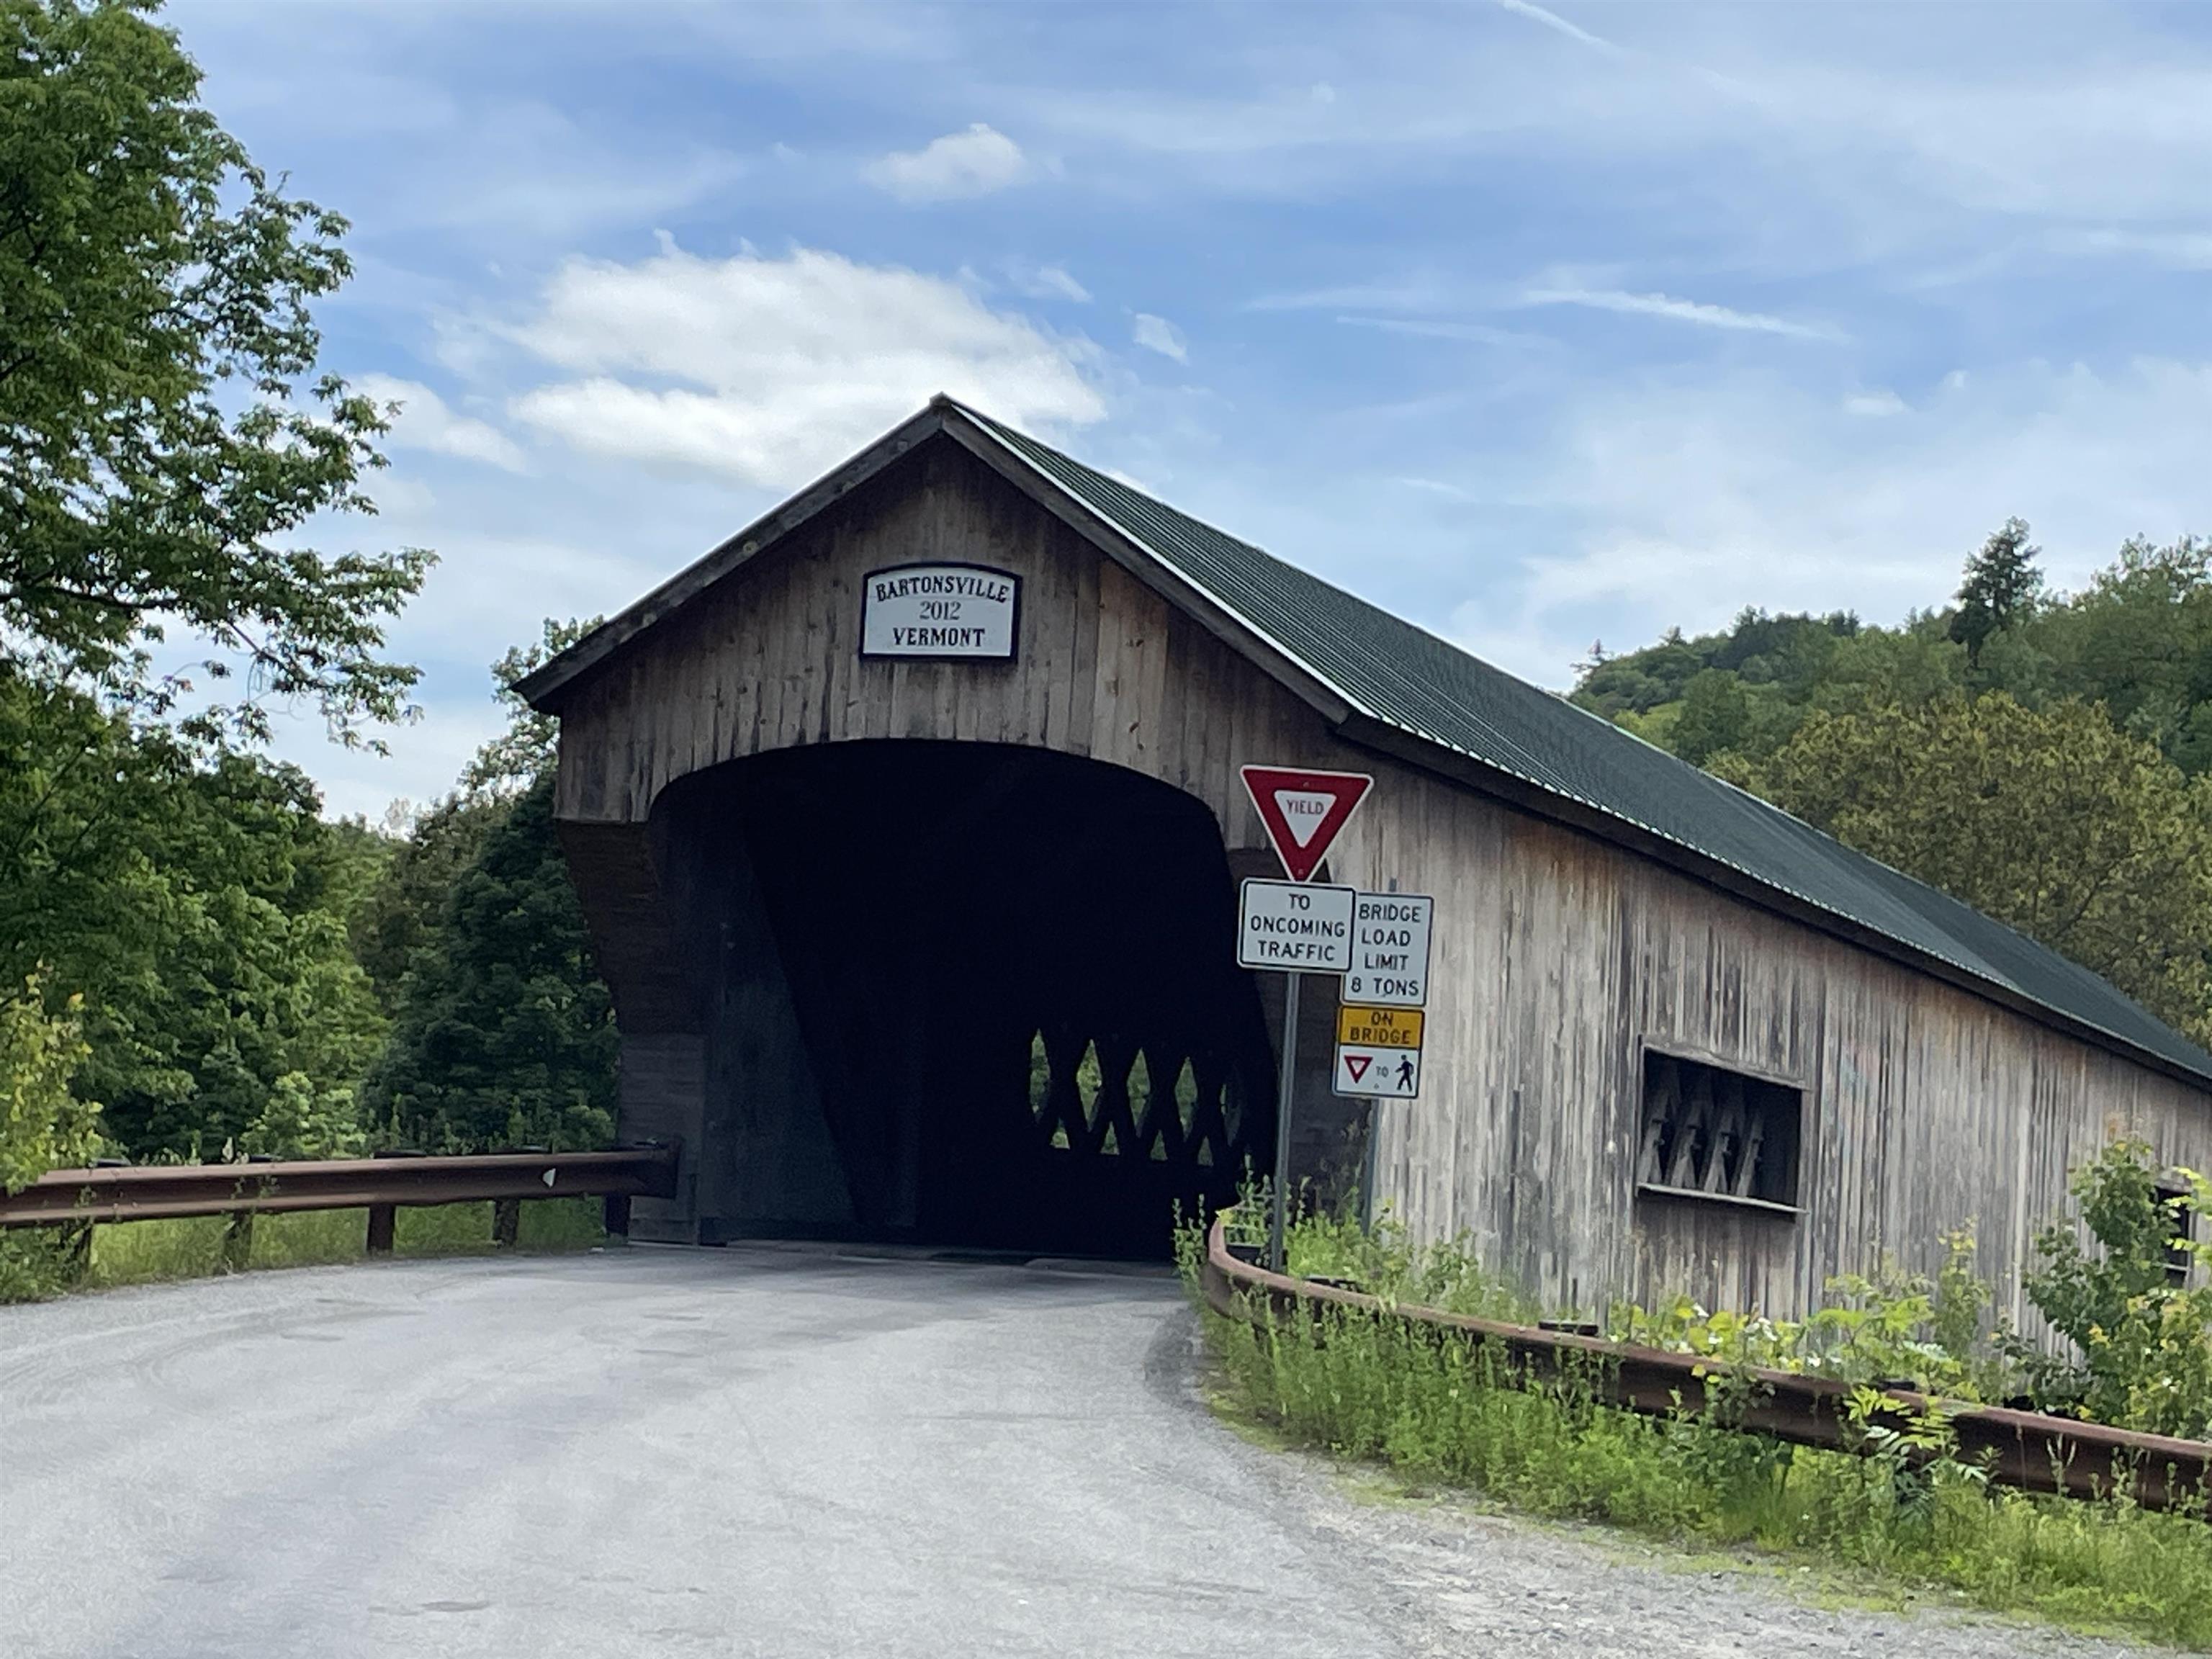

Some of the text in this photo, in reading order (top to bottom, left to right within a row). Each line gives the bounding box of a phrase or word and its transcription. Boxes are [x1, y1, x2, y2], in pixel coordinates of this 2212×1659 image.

[876, 575, 1010, 603] BARTONSVILLE
[920, 601, 961, 621] 2012
[893, 627, 985, 647] VERMONT
[1285, 799, 1324, 815] YIELD
[1288, 894, 1310, 910] TO
[1359, 904, 1422, 923] BRIDGE
[1250, 915, 1345, 938] ONCOMING
[1361, 927, 1411, 947] LOAD
[1258, 940, 1335, 961] TRAFFIC
[1364, 953, 1409, 971] LIMIT
[1351, 977, 1419, 997] 8 TONS
[1371, 1012, 1393, 1027] ON
[1350, 1027, 1412, 1044] BRIDGE
[1375, 1066, 1389, 1078] TO
